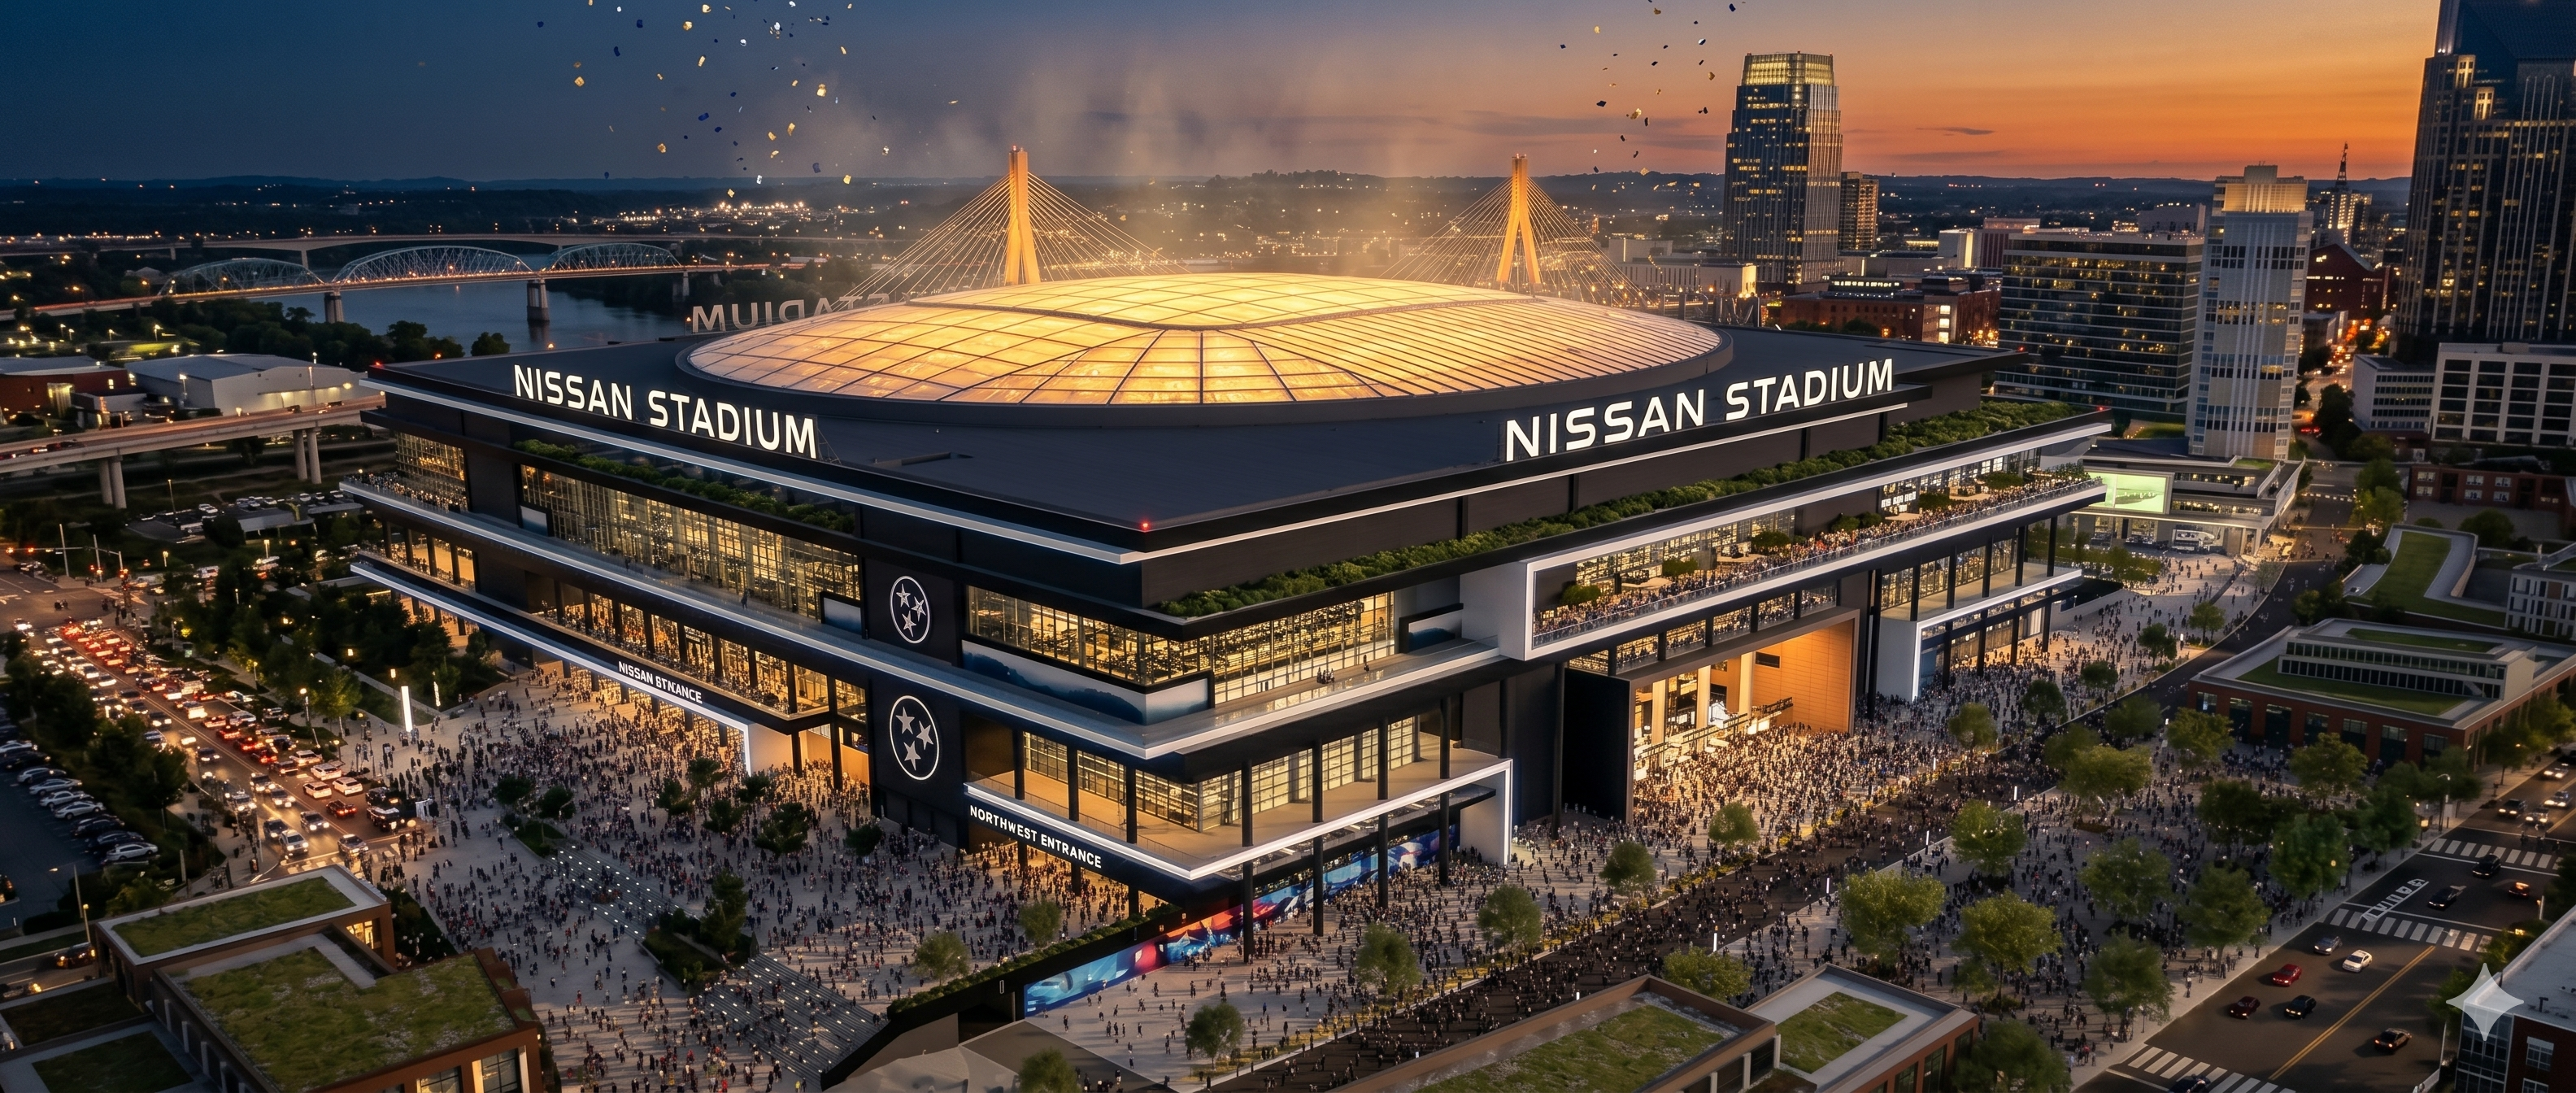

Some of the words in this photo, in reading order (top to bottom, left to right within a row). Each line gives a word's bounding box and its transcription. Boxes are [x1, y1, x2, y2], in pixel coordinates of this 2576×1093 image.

[514, 364, 633, 421] NISSAN
[648, 390, 816, 459] STADIUM
[1506, 388, 1705, 463] NISSAN
[1725, 357, 1893, 422] STADIUM
[618, 660, 654, 685] NISSAN
[970, 804, 1038, 843] NORTHWEST
[1041, 833, 1103, 869] ENTRANCE
